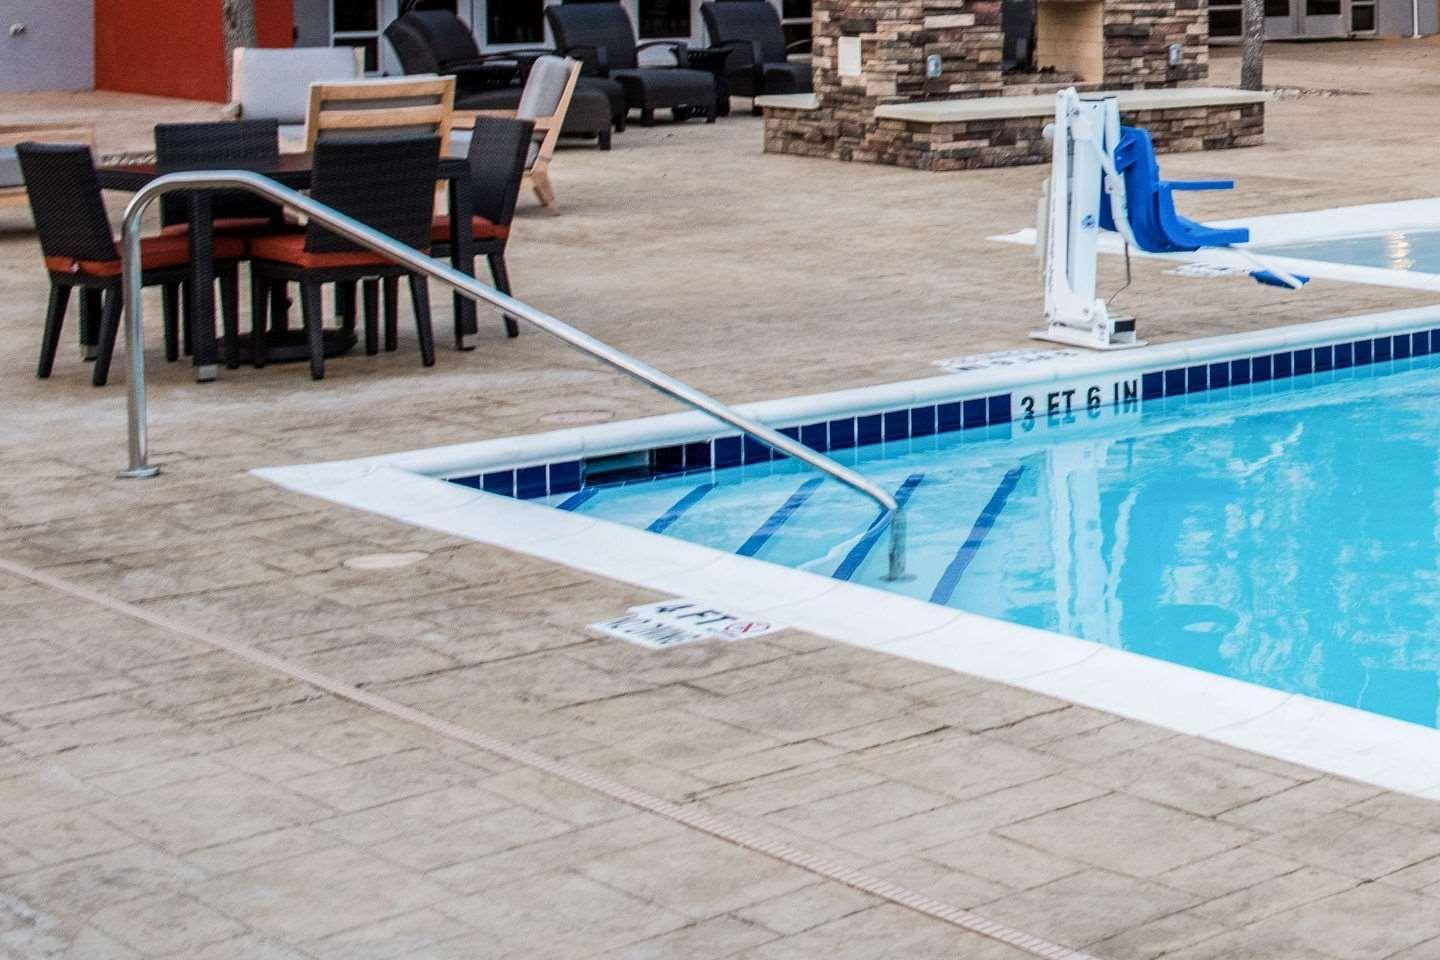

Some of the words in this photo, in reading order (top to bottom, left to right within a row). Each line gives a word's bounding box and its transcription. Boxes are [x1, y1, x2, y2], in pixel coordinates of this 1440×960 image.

[1020, 396, 1036, 421] 3
[1047, 389, 1077, 417] FT
[1087, 386, 1102, 411] 6
[1113, 379, 1139, 406] IN
